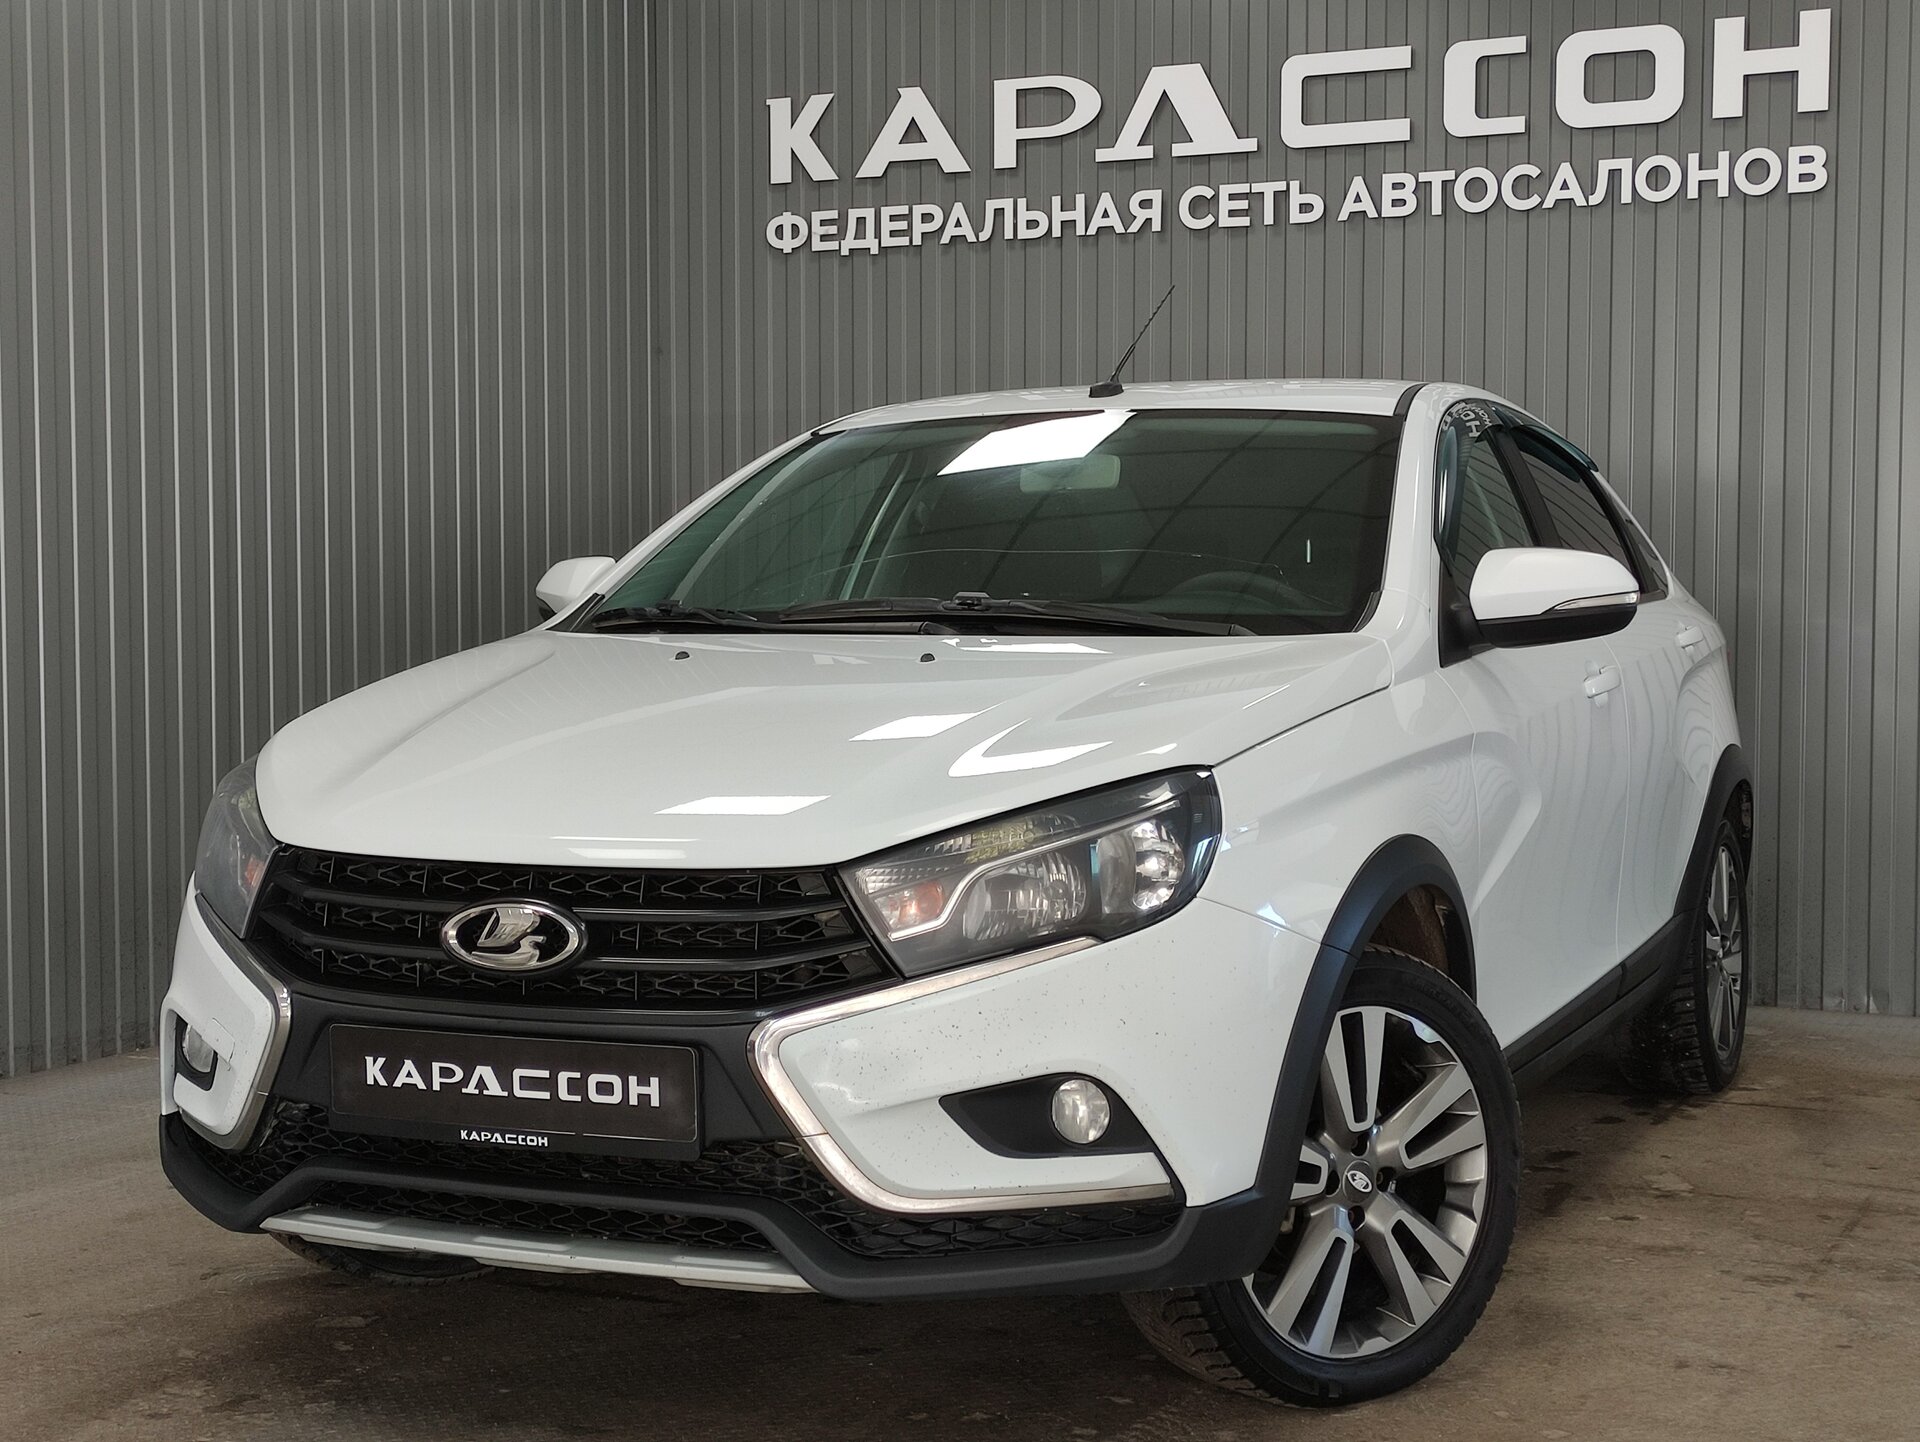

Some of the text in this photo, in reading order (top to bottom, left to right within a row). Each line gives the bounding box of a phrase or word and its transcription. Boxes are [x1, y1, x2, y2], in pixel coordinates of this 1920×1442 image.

[766, 8, 1832, 184] КАРАССОН
[766, 144, 1828, 256] ФЕДЕРАЛЬНАЯ СЕТЬ АВТОСАЛОНОВ
[364, 1055, 661, 1108] КАРАССОН
